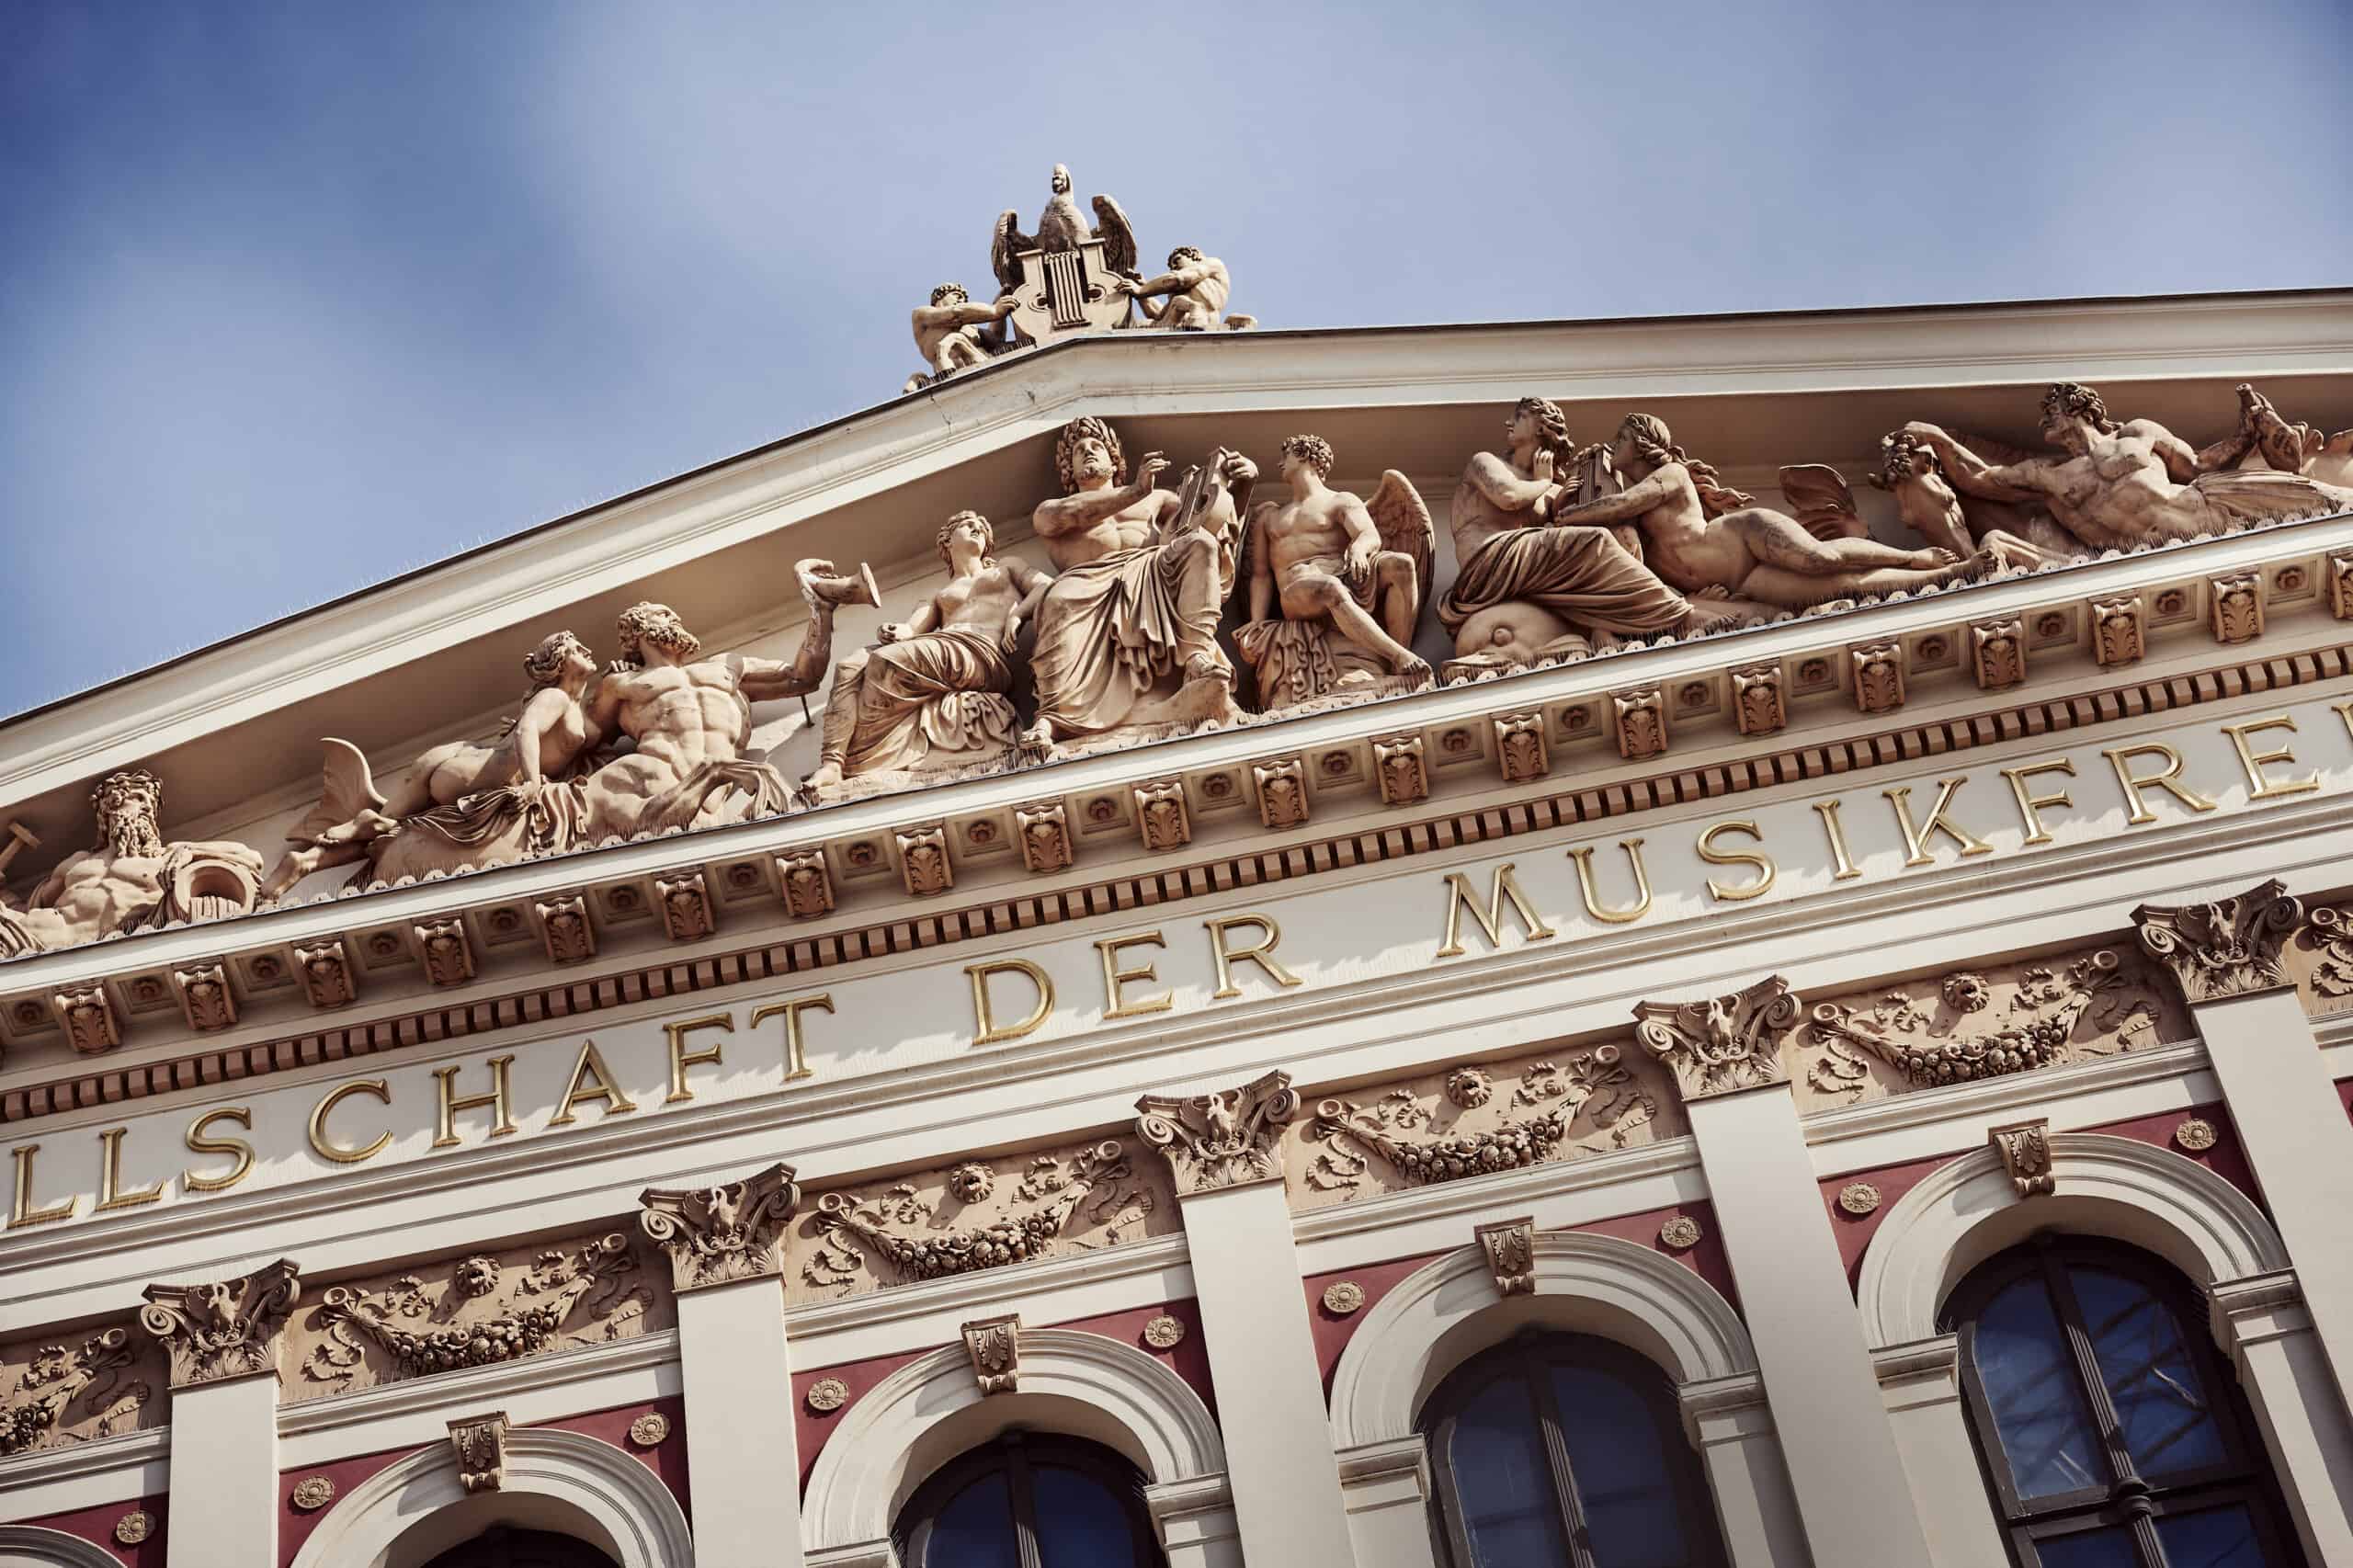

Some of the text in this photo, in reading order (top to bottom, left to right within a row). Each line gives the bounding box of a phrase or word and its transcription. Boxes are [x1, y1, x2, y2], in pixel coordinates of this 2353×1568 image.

[6, 702, 2353, 1230] LLSCHAFT DER MUSIKFRE
